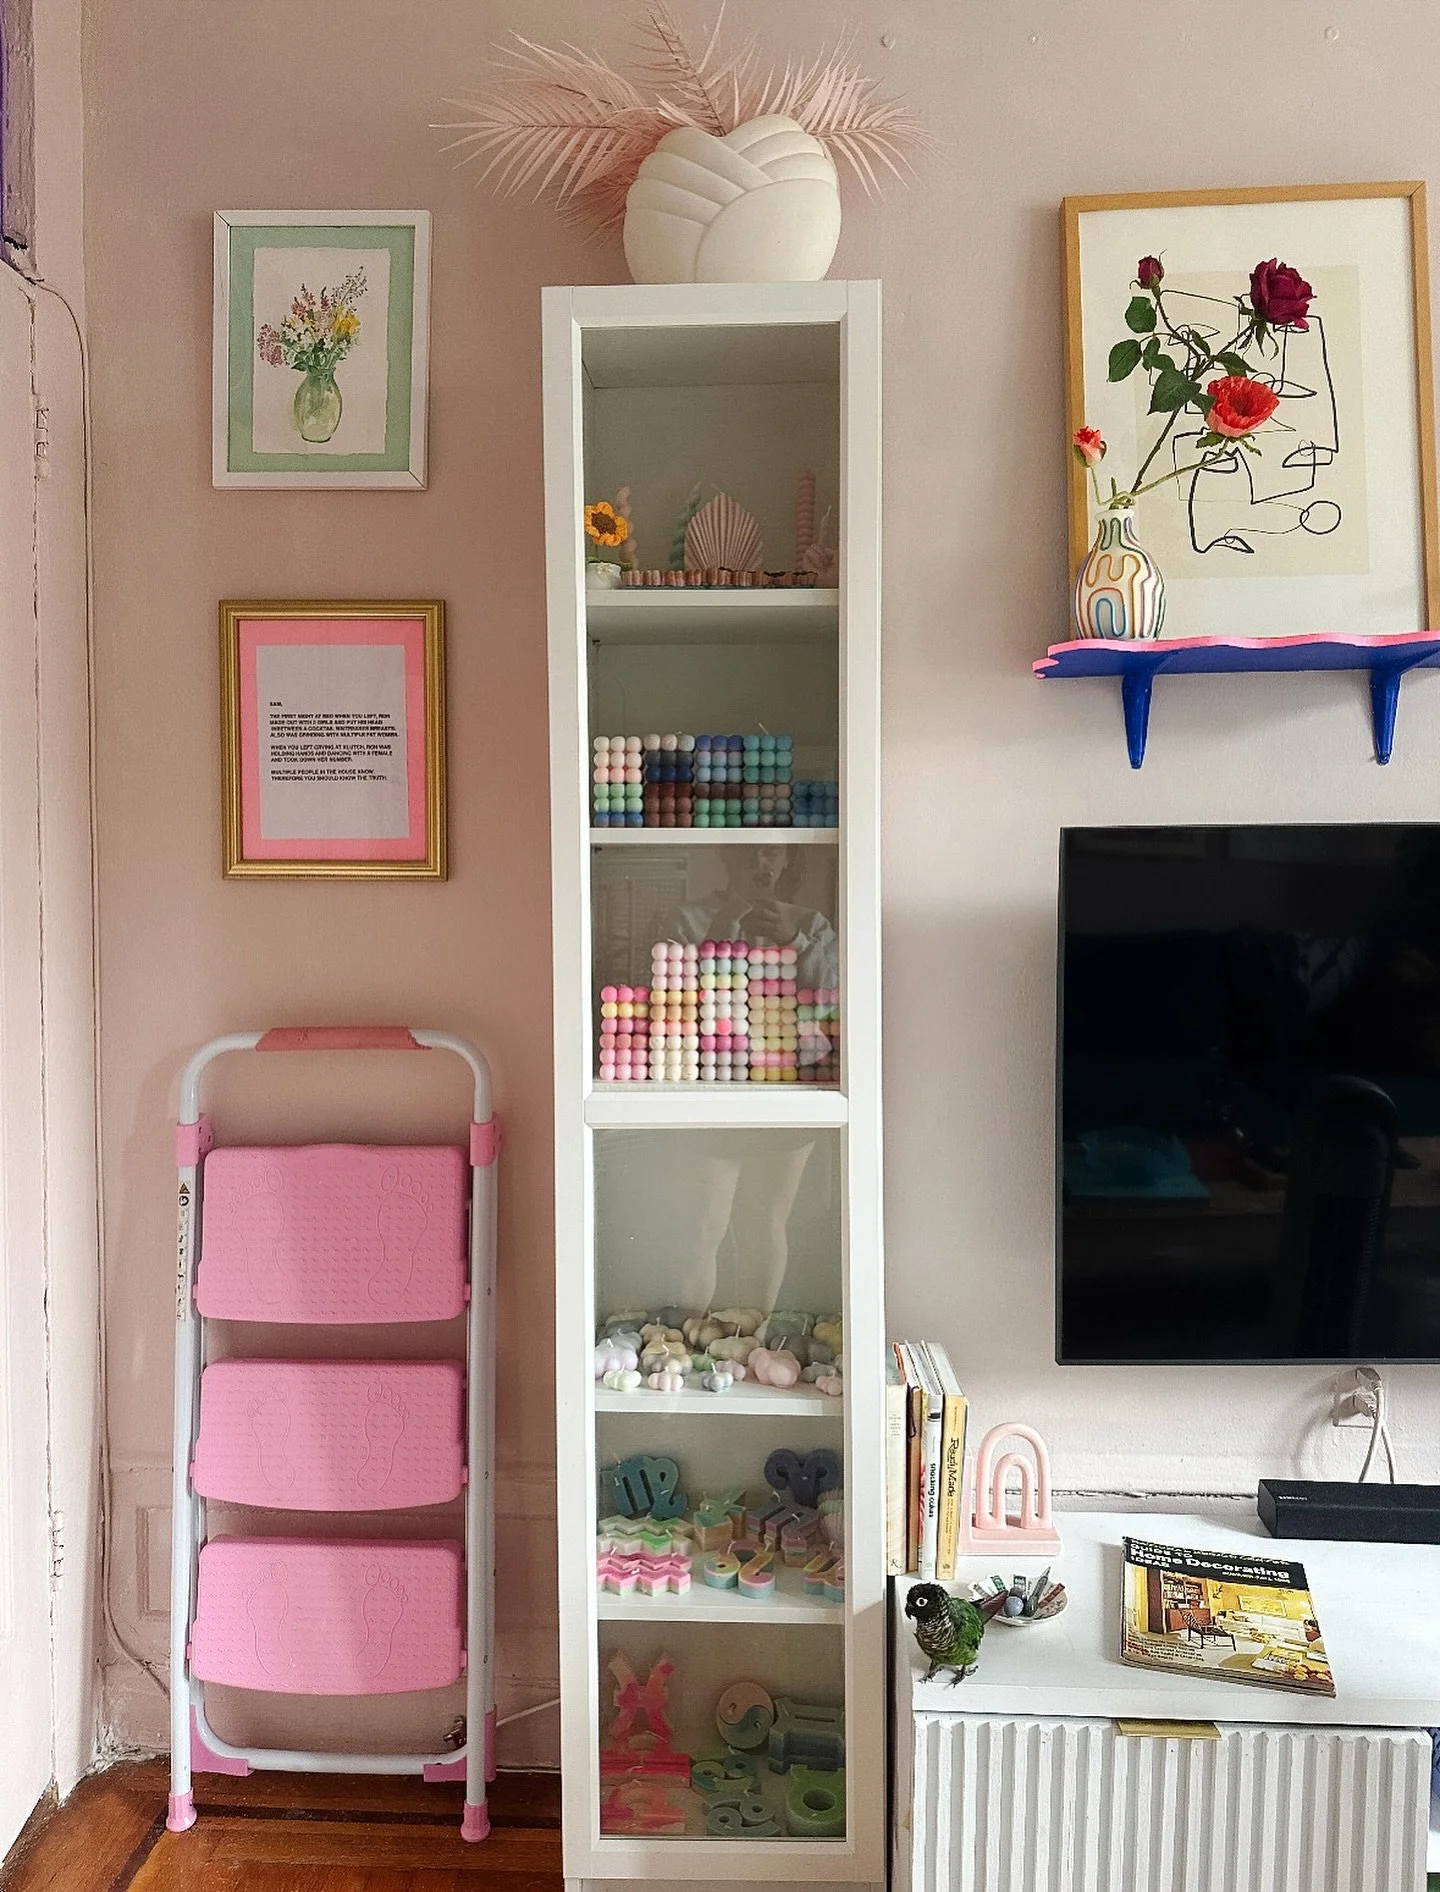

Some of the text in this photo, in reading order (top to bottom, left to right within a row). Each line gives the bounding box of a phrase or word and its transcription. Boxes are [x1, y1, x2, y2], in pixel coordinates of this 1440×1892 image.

[1130, 1544, 1171, 1556] GUIDE
[1130, 1548, 1182, 1564] Home
[1186, 1558, 1290, 1578] Decorating
[1131, 1556, 1170, 1568] IDEAS
